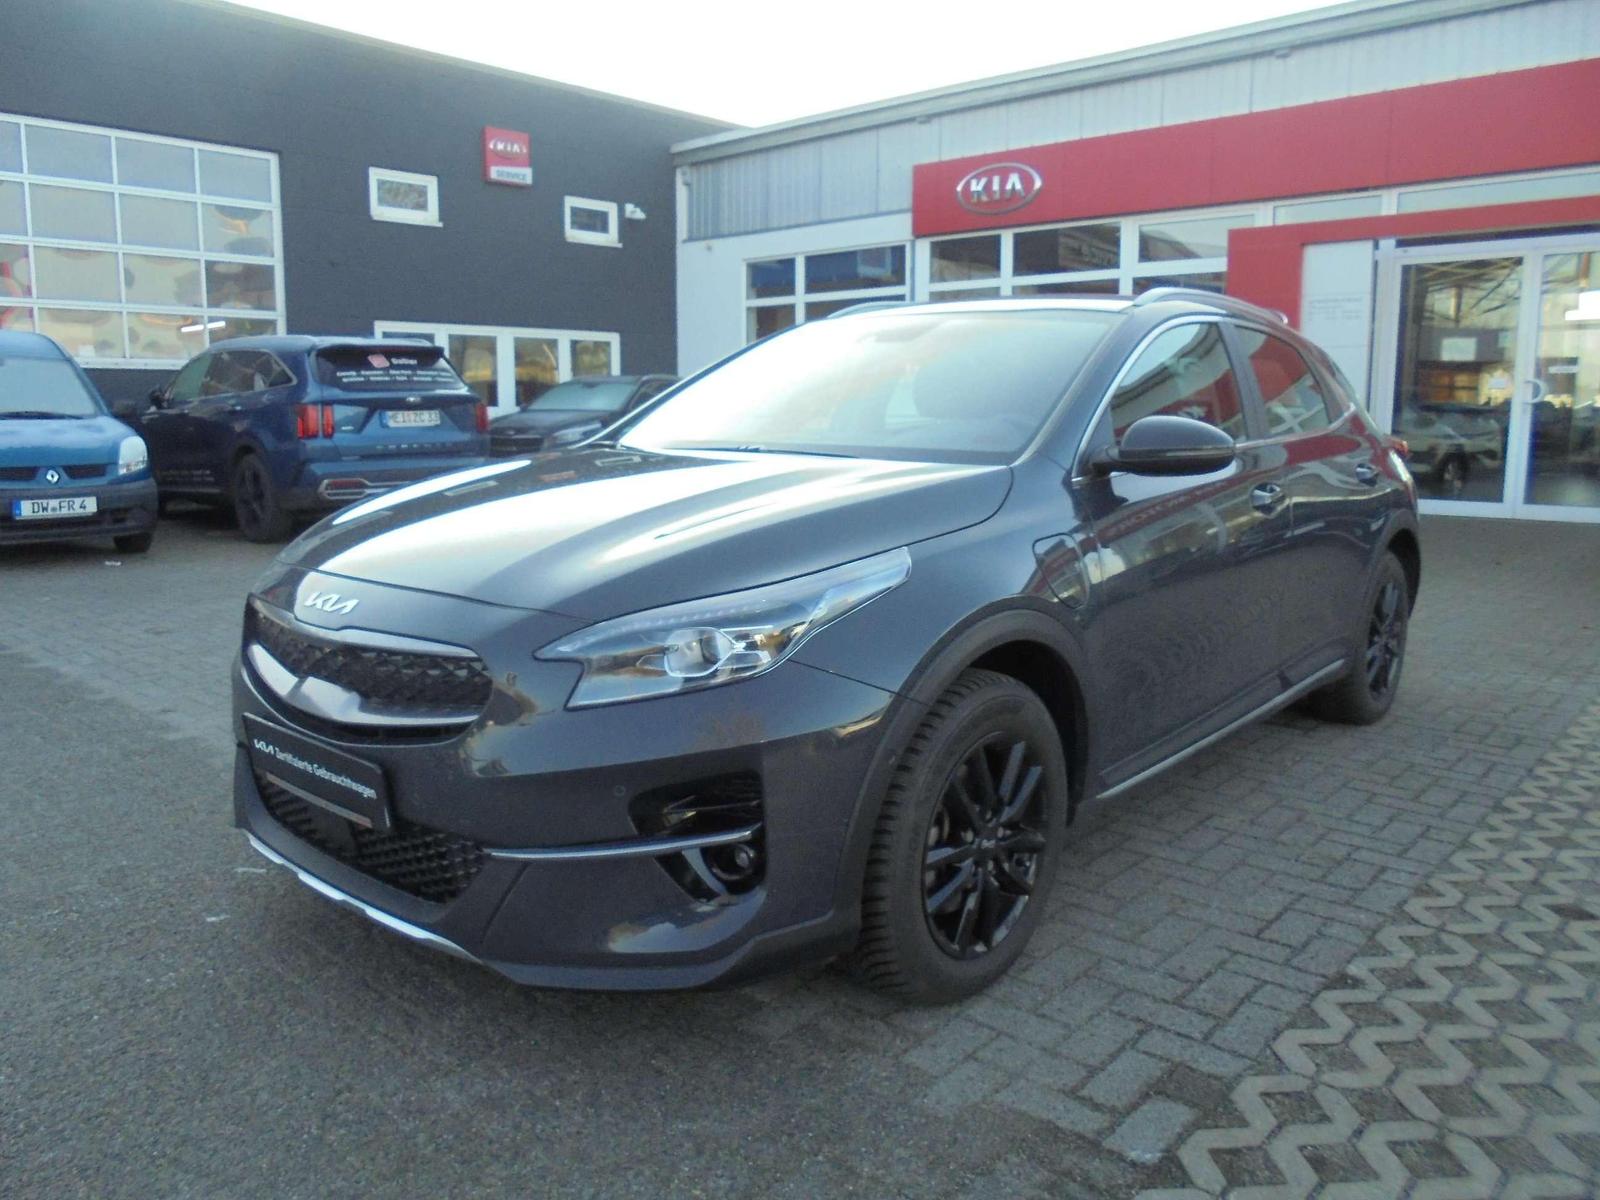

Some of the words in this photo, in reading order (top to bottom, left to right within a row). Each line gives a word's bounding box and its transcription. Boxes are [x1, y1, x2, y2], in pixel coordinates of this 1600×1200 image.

[496, 140, 521, 153] KIA
[970, 172, 1025, 202] KIA
[31, 501, 49, 514] DW
[59, 500, 75, 512] FR
[79, 499, 87, 510] 4
[304, 592, 359, 615] KIA
[254, 738, 275, 755] KIA
